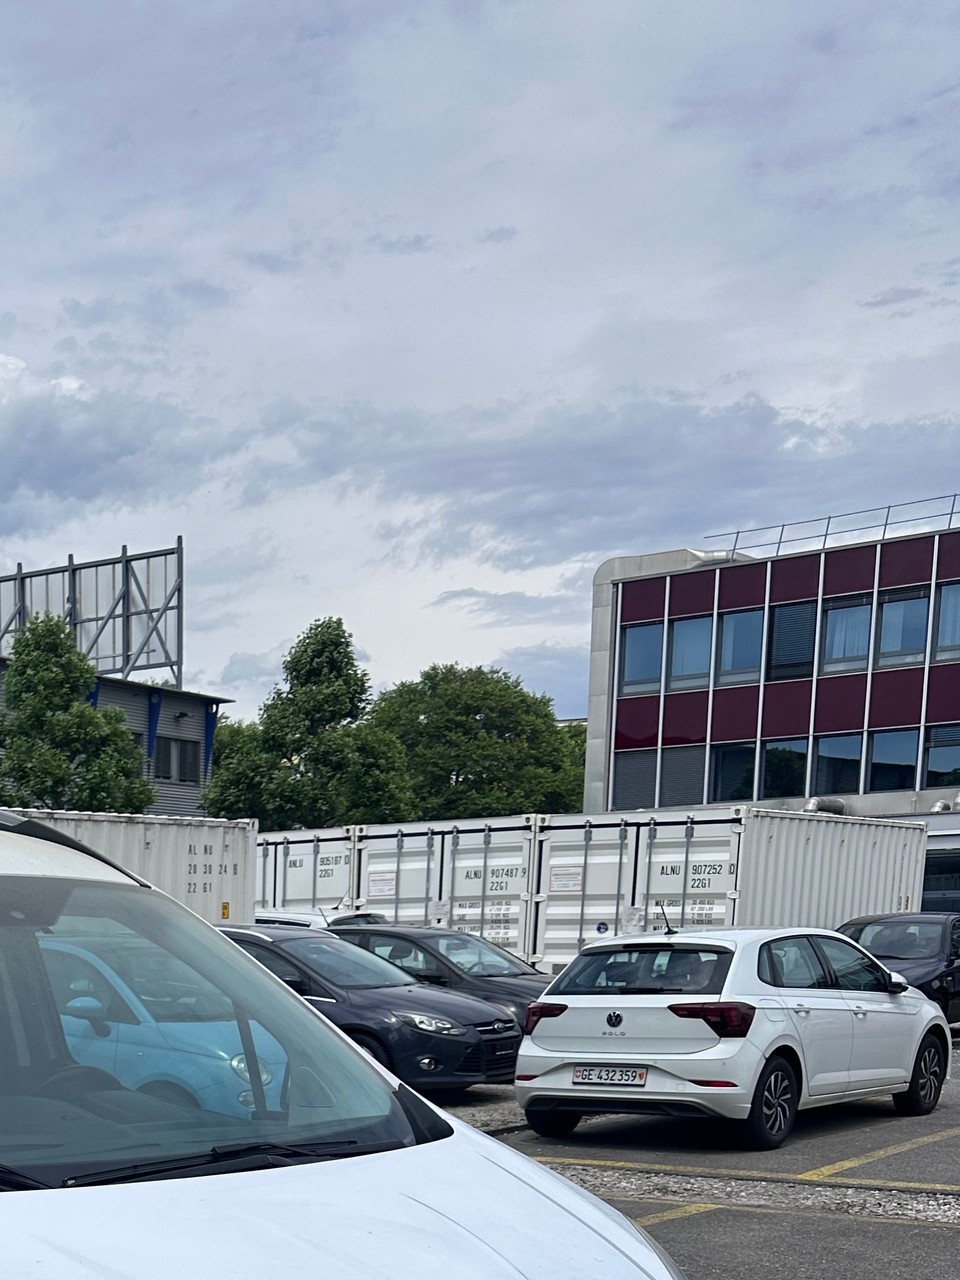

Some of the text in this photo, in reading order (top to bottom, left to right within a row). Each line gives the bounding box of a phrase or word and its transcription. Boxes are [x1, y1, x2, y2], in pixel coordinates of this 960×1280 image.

[465, 870, 482, 880] ALNU
[491, 868, 519, 878] 907487
[660, 865, 681, 876] ALNU
[692, 864, 723, 875] 907252
